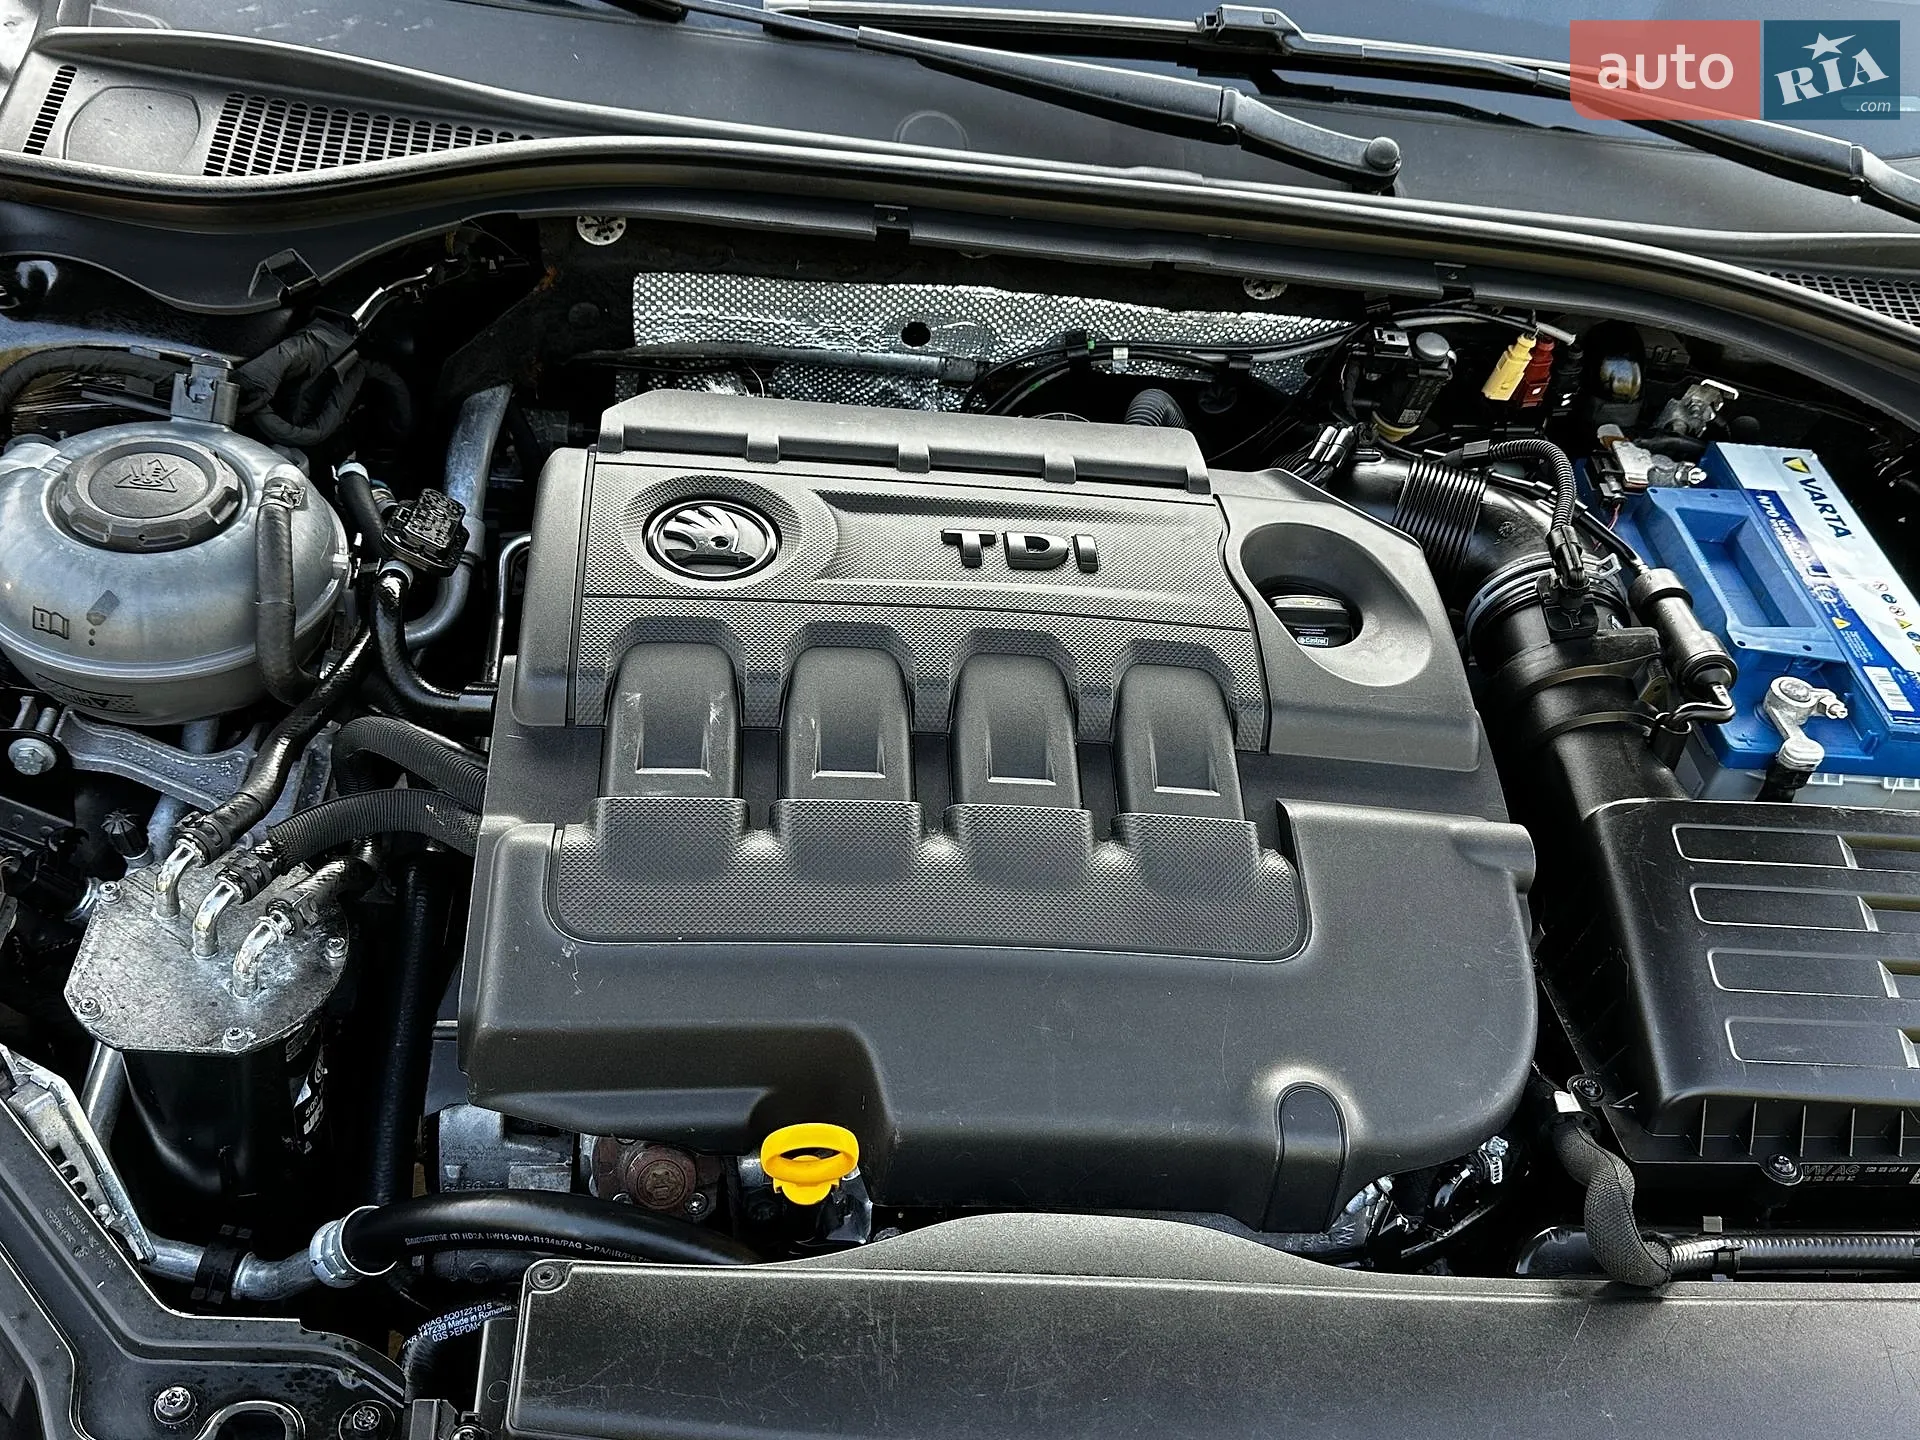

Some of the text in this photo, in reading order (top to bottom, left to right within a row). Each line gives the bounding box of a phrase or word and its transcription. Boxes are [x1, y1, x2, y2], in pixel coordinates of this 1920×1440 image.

[1798, 477, 1852, 538] VARTA
[940, 528, 1099, 574] TDI
[448, 1316, 469, 1329] Made
[479, 1304, 512, 1321] Romania
